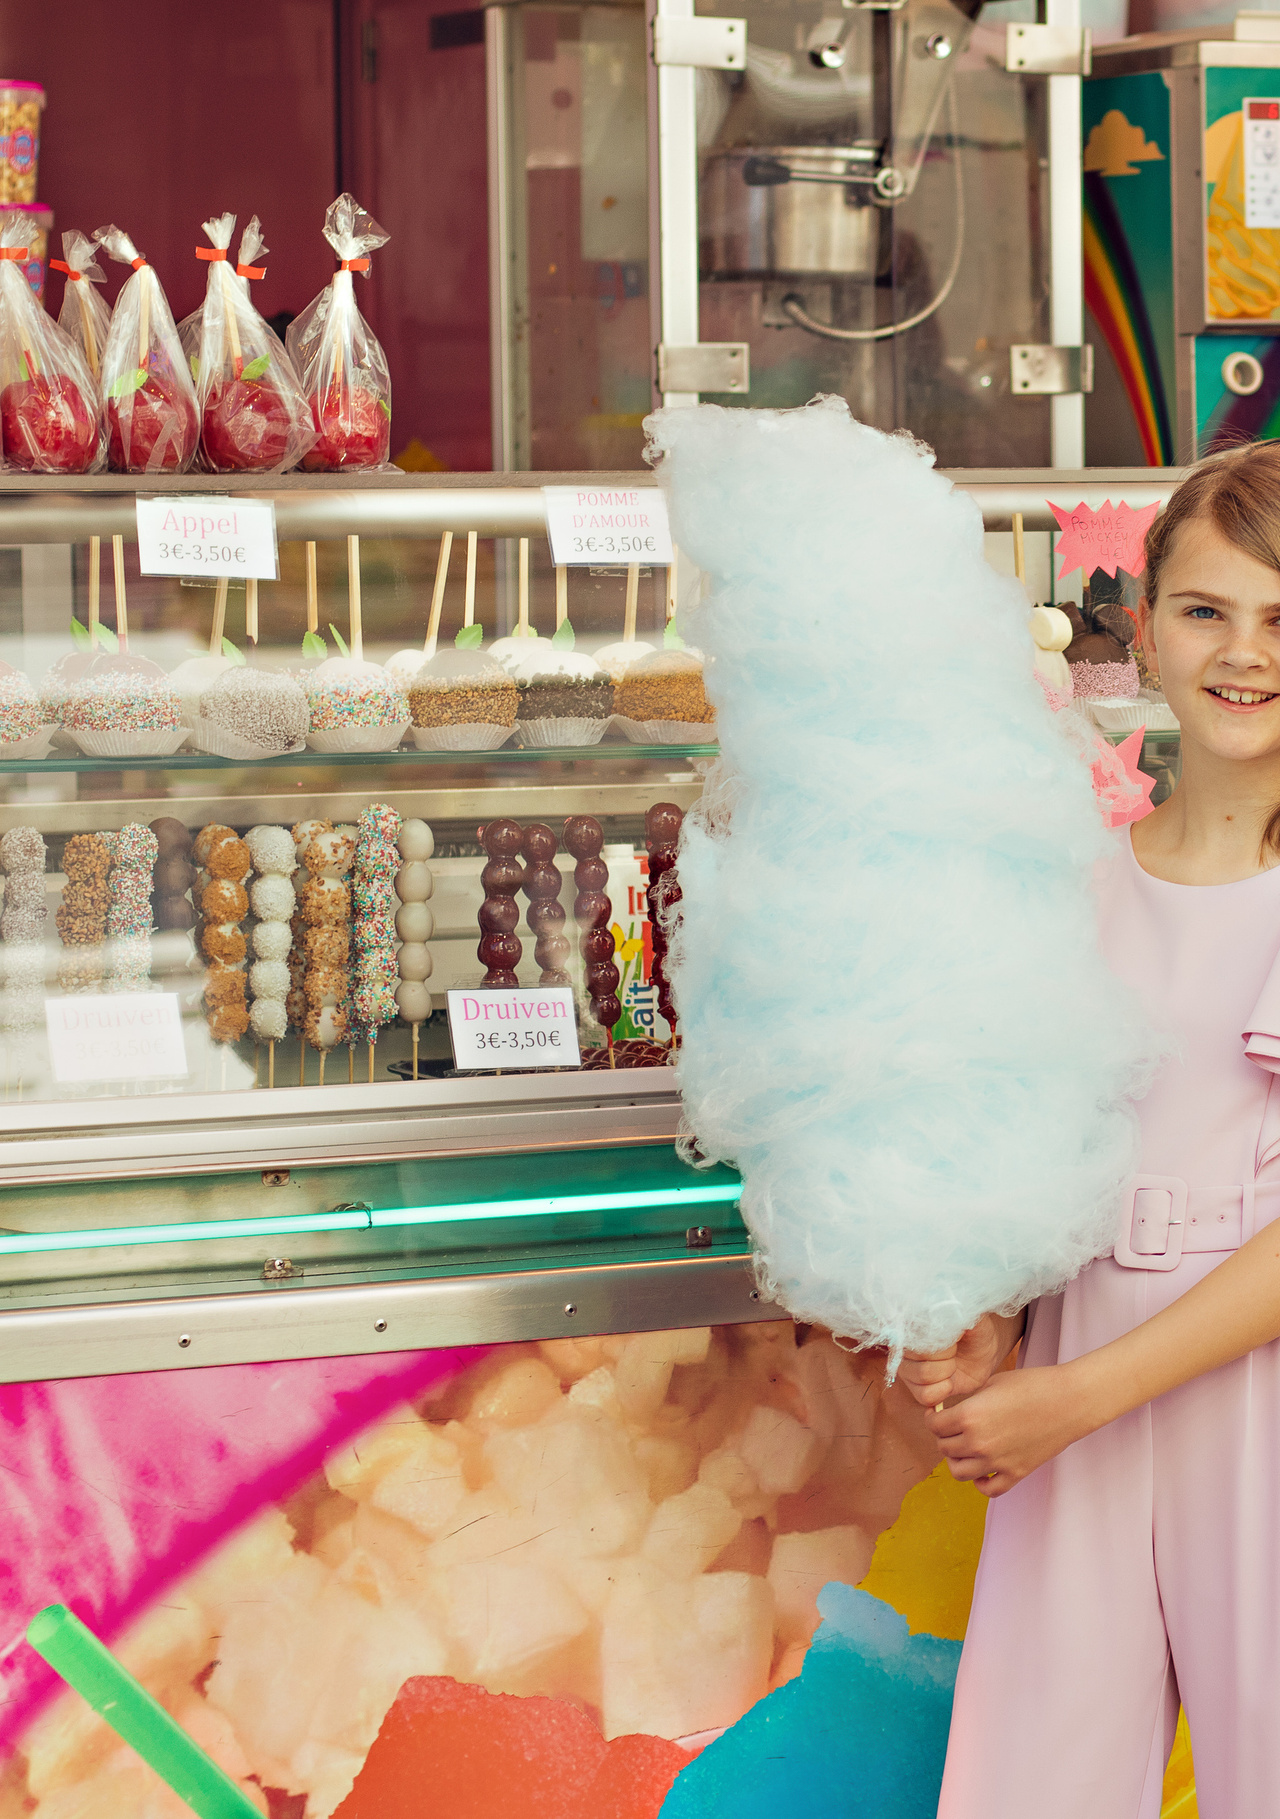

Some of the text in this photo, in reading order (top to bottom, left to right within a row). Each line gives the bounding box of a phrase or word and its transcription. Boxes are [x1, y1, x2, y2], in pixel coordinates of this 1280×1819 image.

[576, 491, 640, 507] POMME
[161, 508, 239, 540] Appel
[572, 513, 650, 529] D'AMOUR
[1071, 515, 1125, 532] POMME
[159, 542, 247, 563] 3€-3,50€
[573, 536, 656, 554] 3€-3,50€
[1099, 543, 1125, 562] 4€
[60, 1002, 173, 1032] Druiven
[462, 996, 570, 1022] Druiven
[475, 1030, 563, 1051] 3€-3,50€
